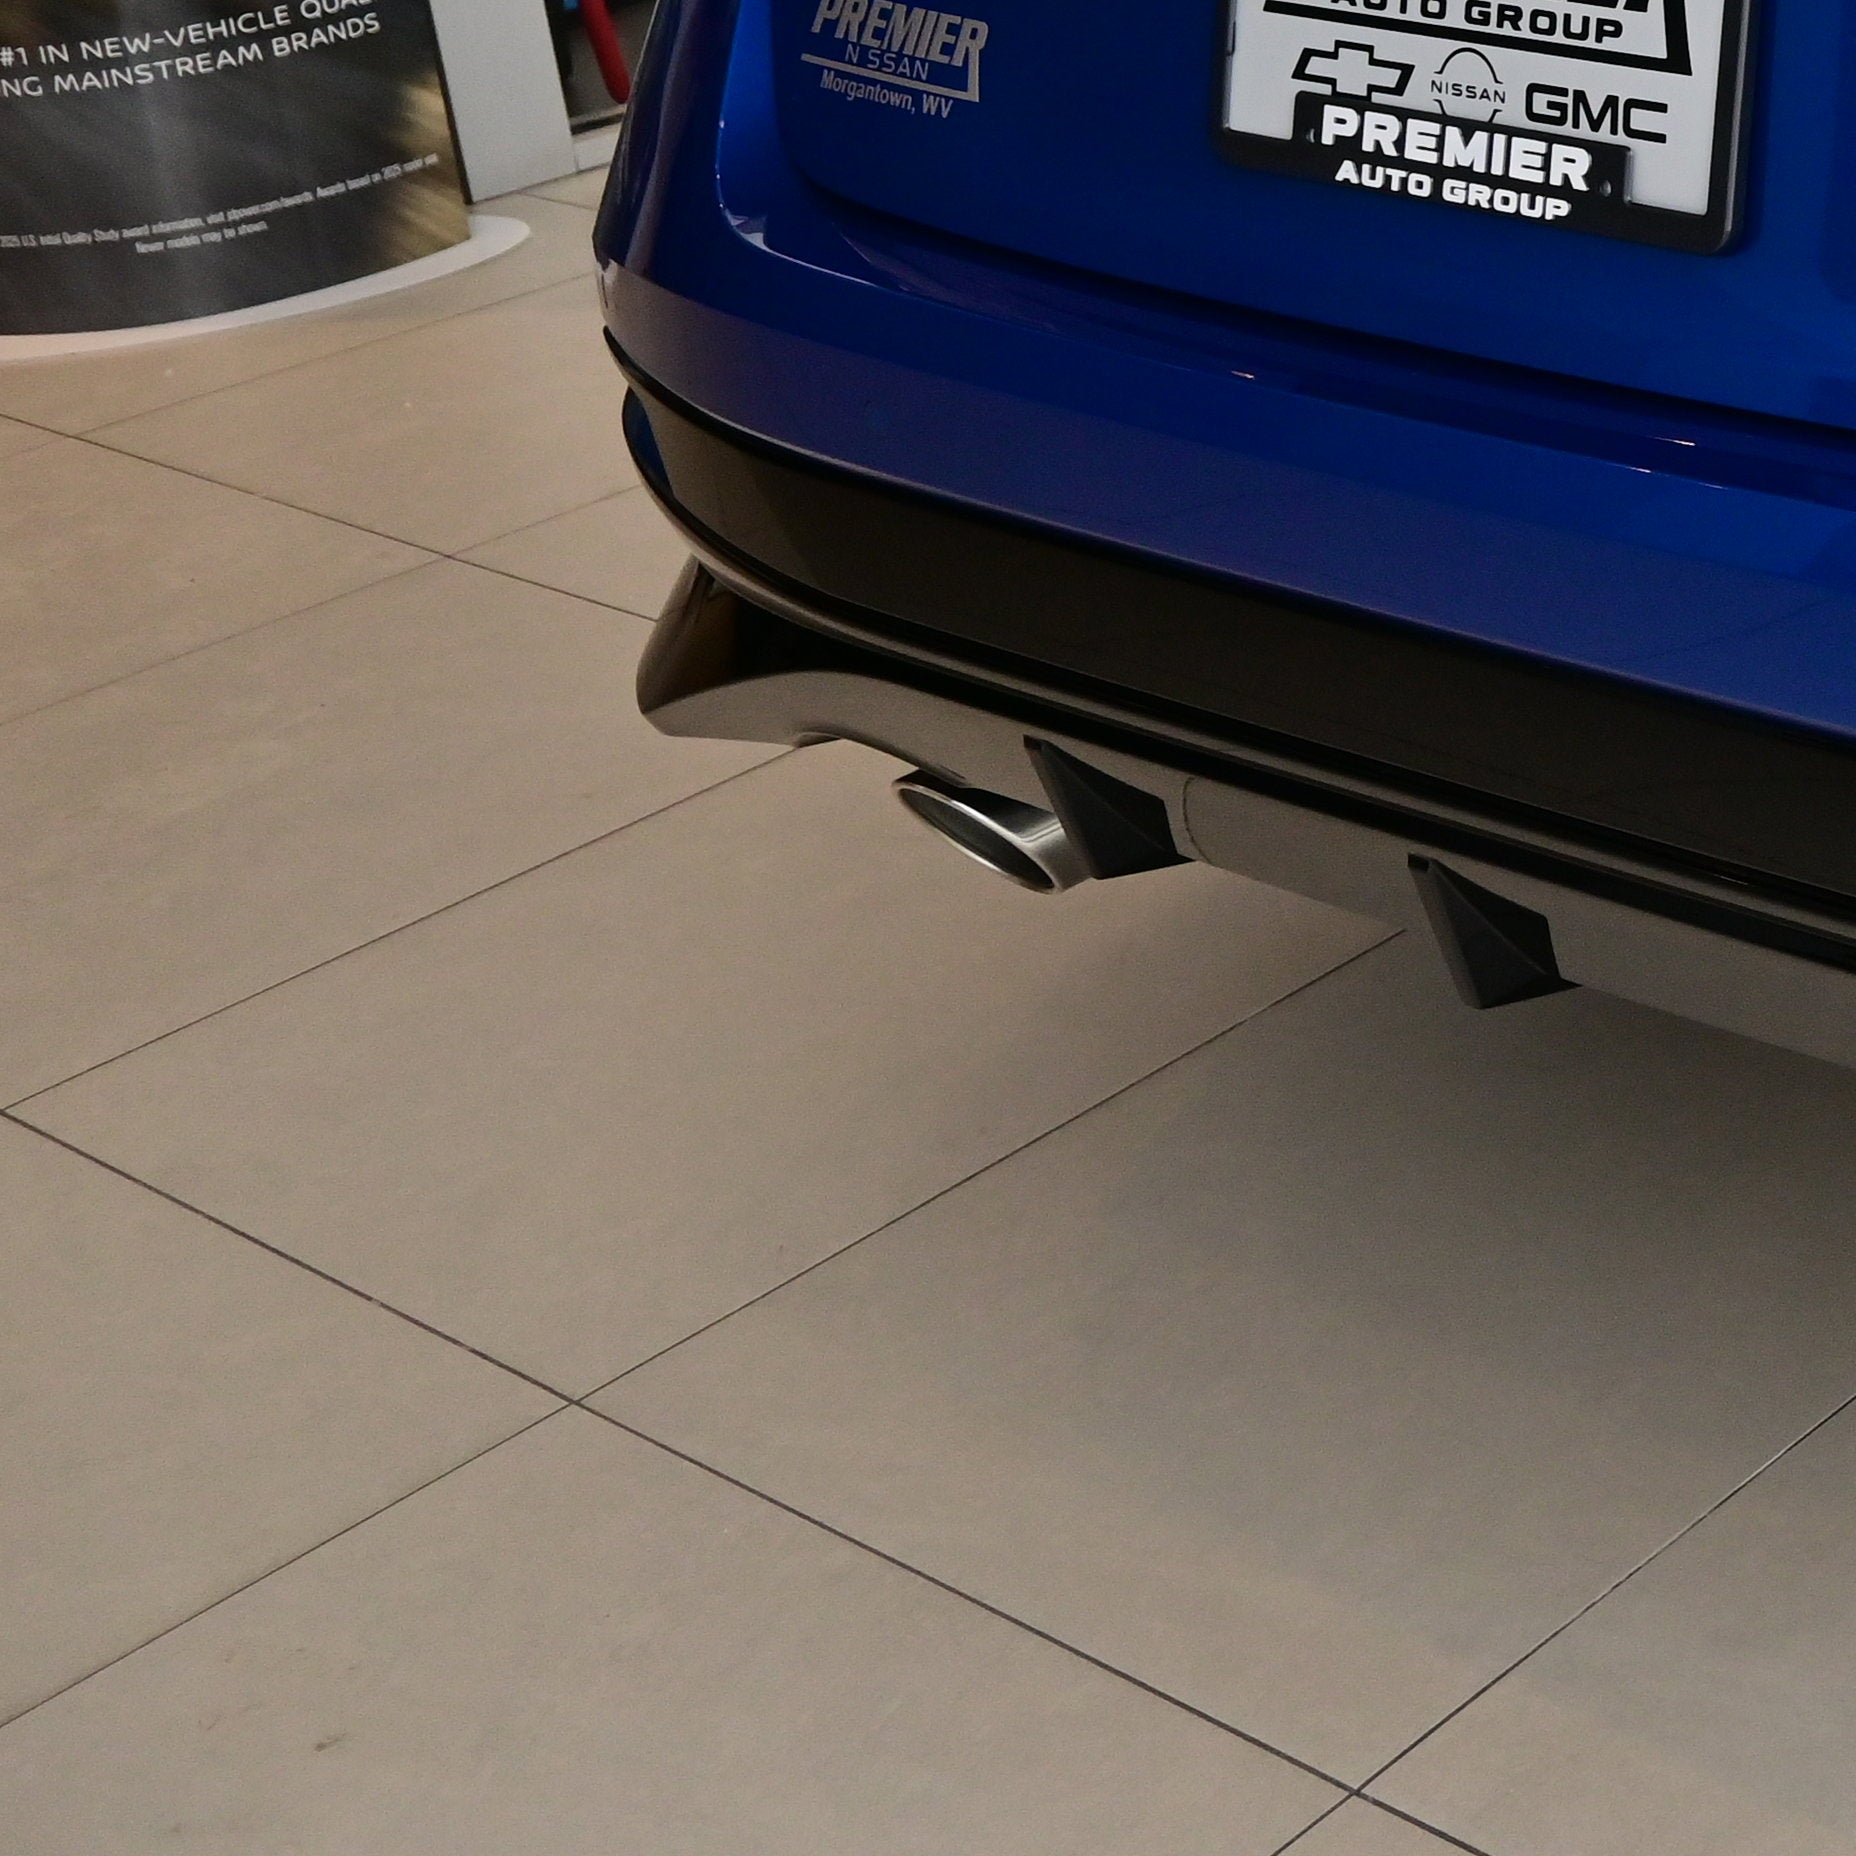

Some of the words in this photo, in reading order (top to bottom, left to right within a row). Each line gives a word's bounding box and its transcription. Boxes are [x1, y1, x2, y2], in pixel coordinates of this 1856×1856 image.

[0, 46, 28, 67] #1
[38, 44, 69, 64] IN
[80, 4, 292, 62] NEW-VEHICLE
[53, 42, 264, 95] MAINSTREAM
[272, 12, 382, 59] BRANDS
[1464, 0, 1624, 45] GROUP
[844, 43, 929, 81] NSSAN
[820, 68, 916, 115] Morgantown,
[922, 94, 954, 119] WV
[1430, 79, 1507, 105] NISSAN
[1525, 82, 1669, 144] GMC
[1321, 103, 1592, 192] PREMIER
[1334, 159, 1434, 199] AUTO
[1441, 178, 1572, 221] GROUP
